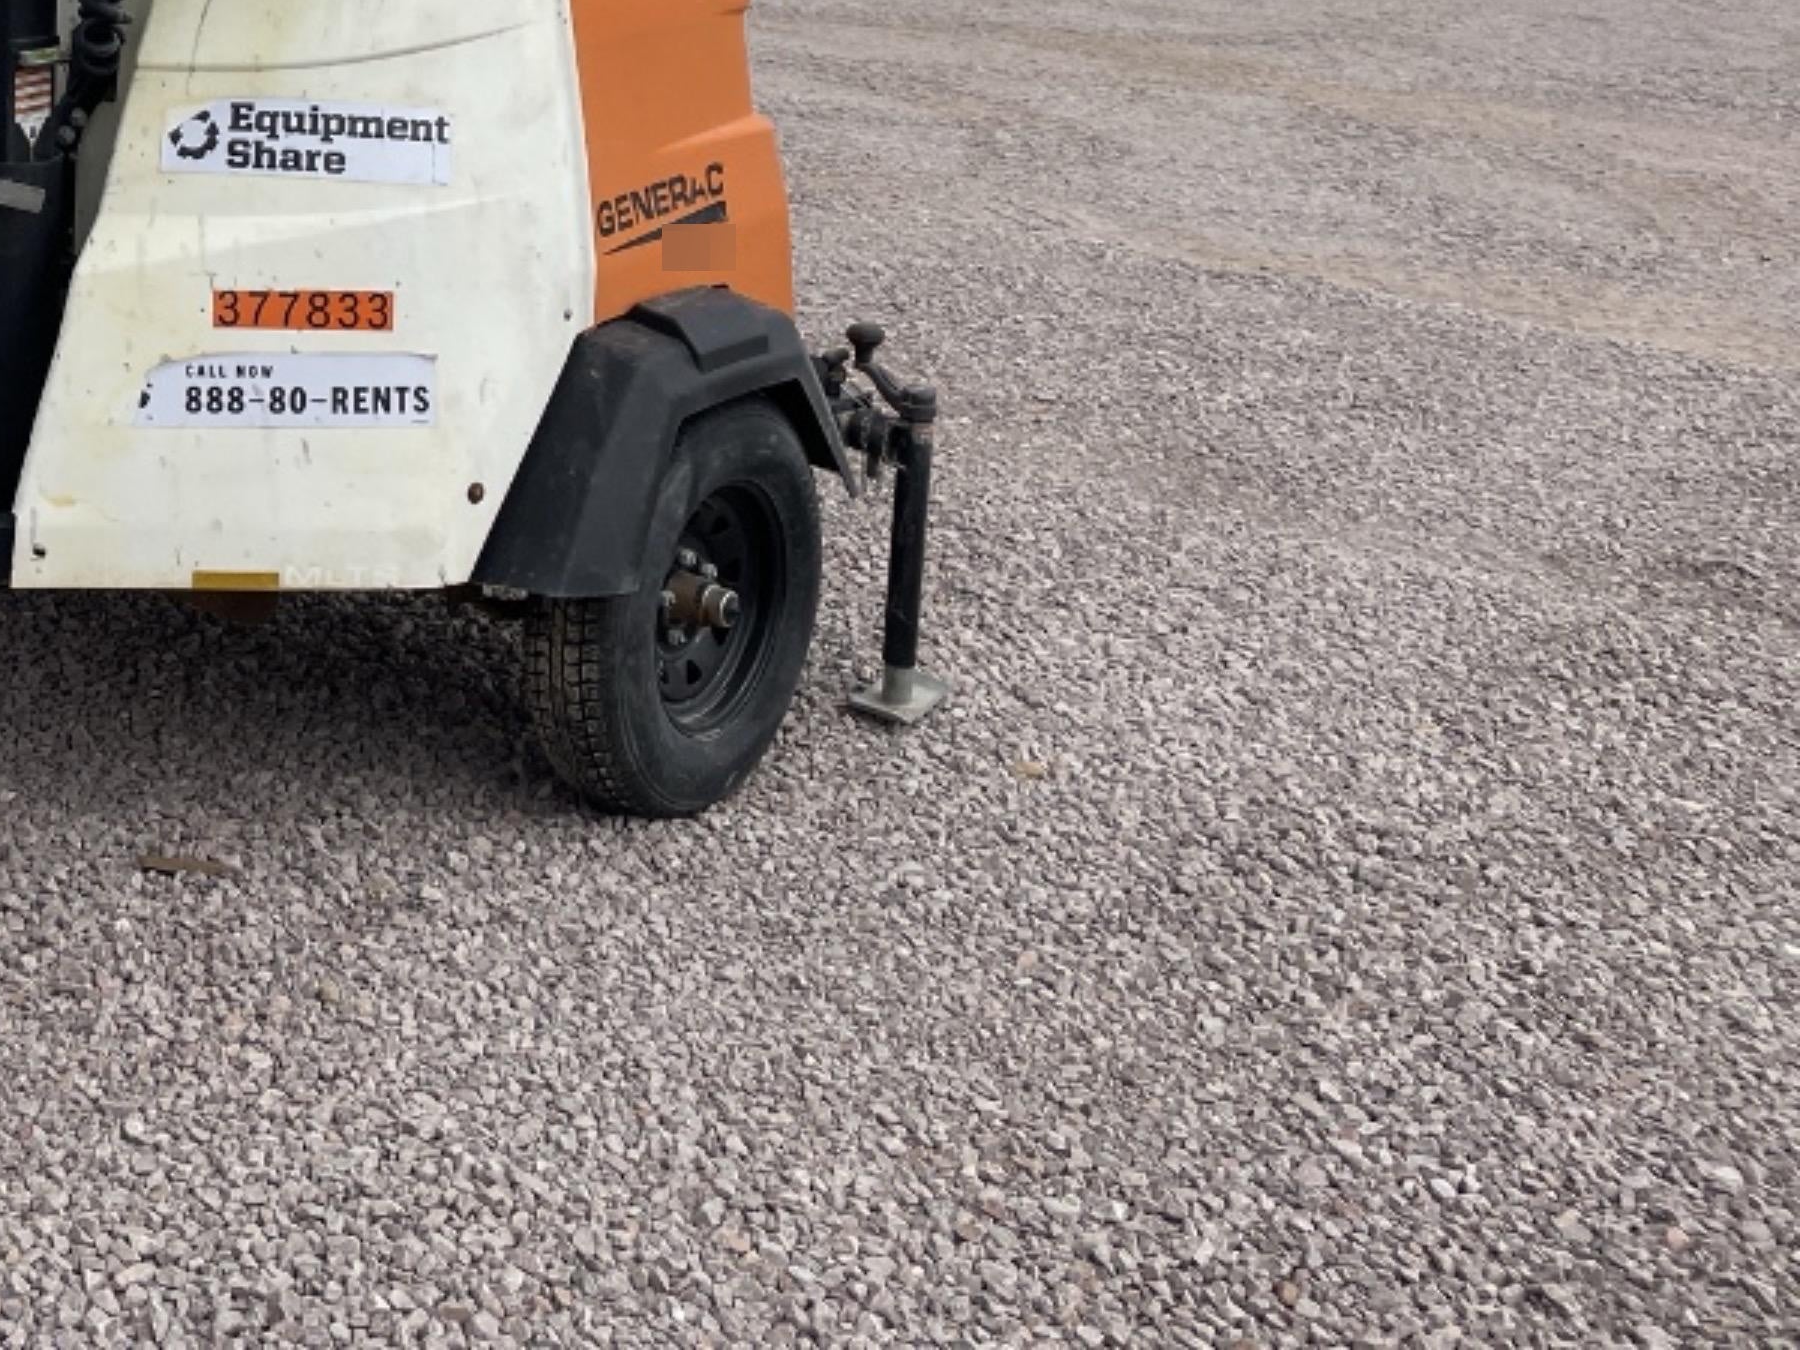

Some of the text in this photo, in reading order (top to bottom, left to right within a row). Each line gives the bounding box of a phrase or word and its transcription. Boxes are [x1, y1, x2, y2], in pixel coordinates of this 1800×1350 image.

[228, 102, 451, 144] Equipment
[226, 138, 347, 174] Share
[597, 162, 724, 238] GENERAC
[216, 291, 389, 330] 377833
[185, 364, 274, 379] CALL NOW
[185, 385, 431, 416] 888-80-RENTS
